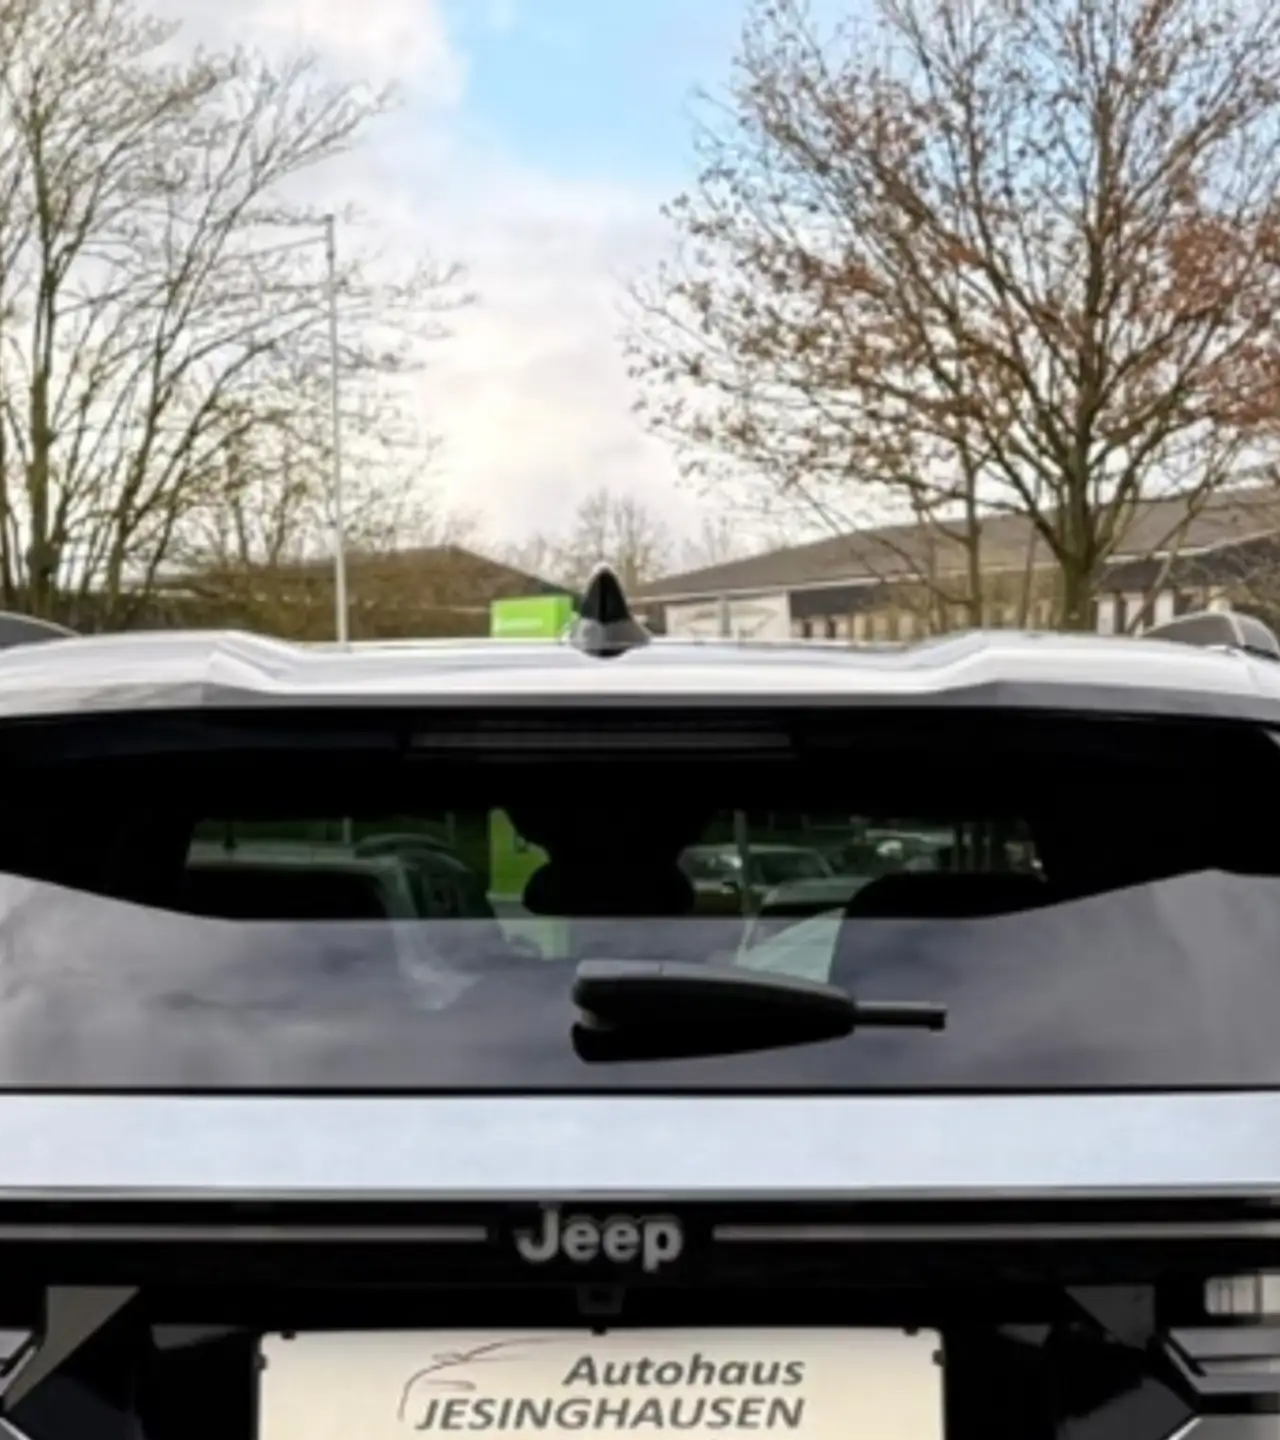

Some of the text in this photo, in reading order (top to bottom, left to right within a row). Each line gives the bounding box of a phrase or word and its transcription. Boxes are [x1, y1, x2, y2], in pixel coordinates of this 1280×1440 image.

[515, 1205, 684, 1273] Jeep
[561, 1353, 806, 1387] Autohaus
[414, 1396, 806, 1432] JESINGHAUSEN
